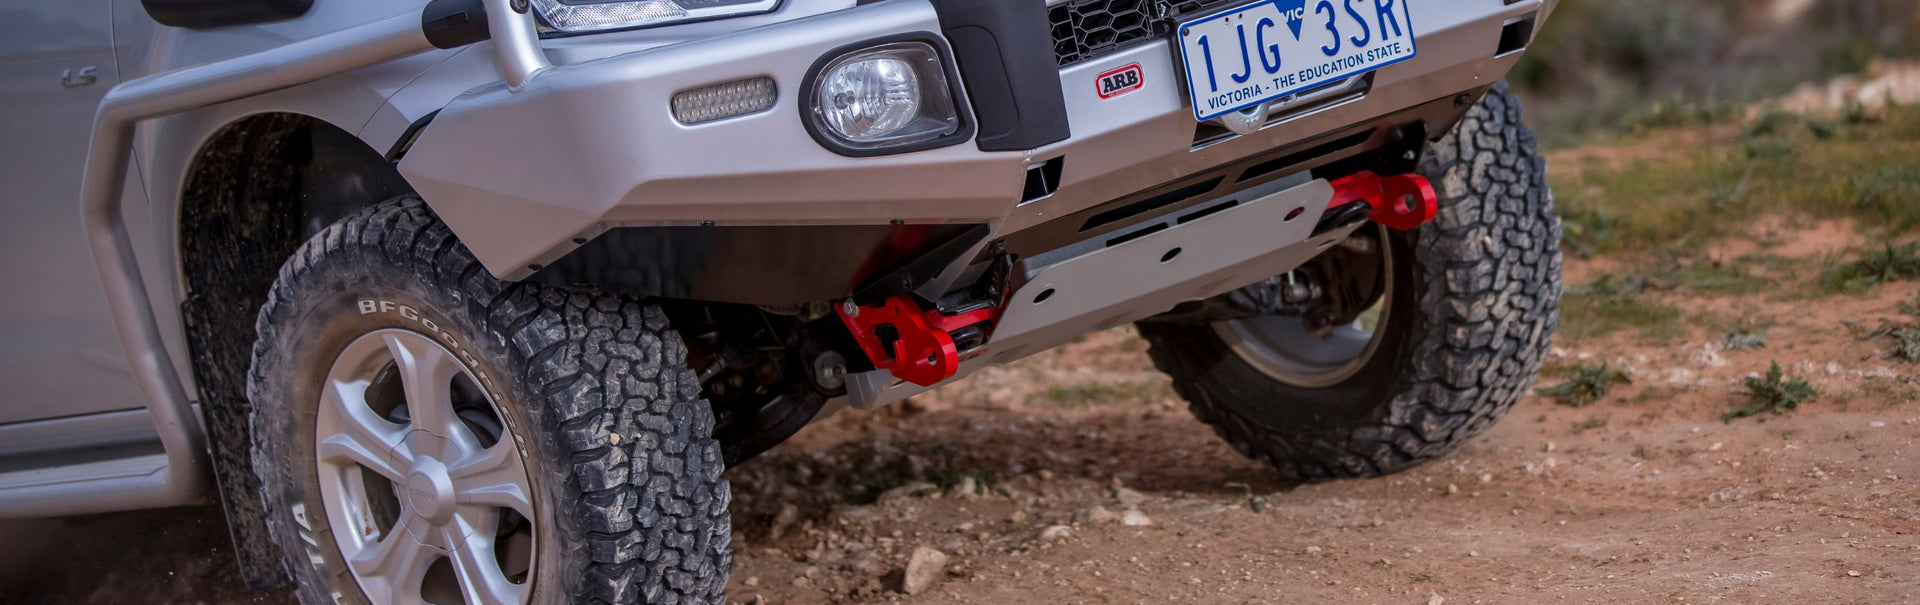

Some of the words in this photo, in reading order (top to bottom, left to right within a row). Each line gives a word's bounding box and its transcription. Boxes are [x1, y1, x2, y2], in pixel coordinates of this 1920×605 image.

[62, 65, 97, 88] LS
[1197, 17, 1281, 93] 1JG
[1208, 84, 1262, 109] VICTORIA
[1273, 73, 1296, 90] THE
[1299, 53, 1364, 83] EDUCATION
[1367, 42, 1401, 61] STATE
[1102, 70, 1138, 93] ARB
